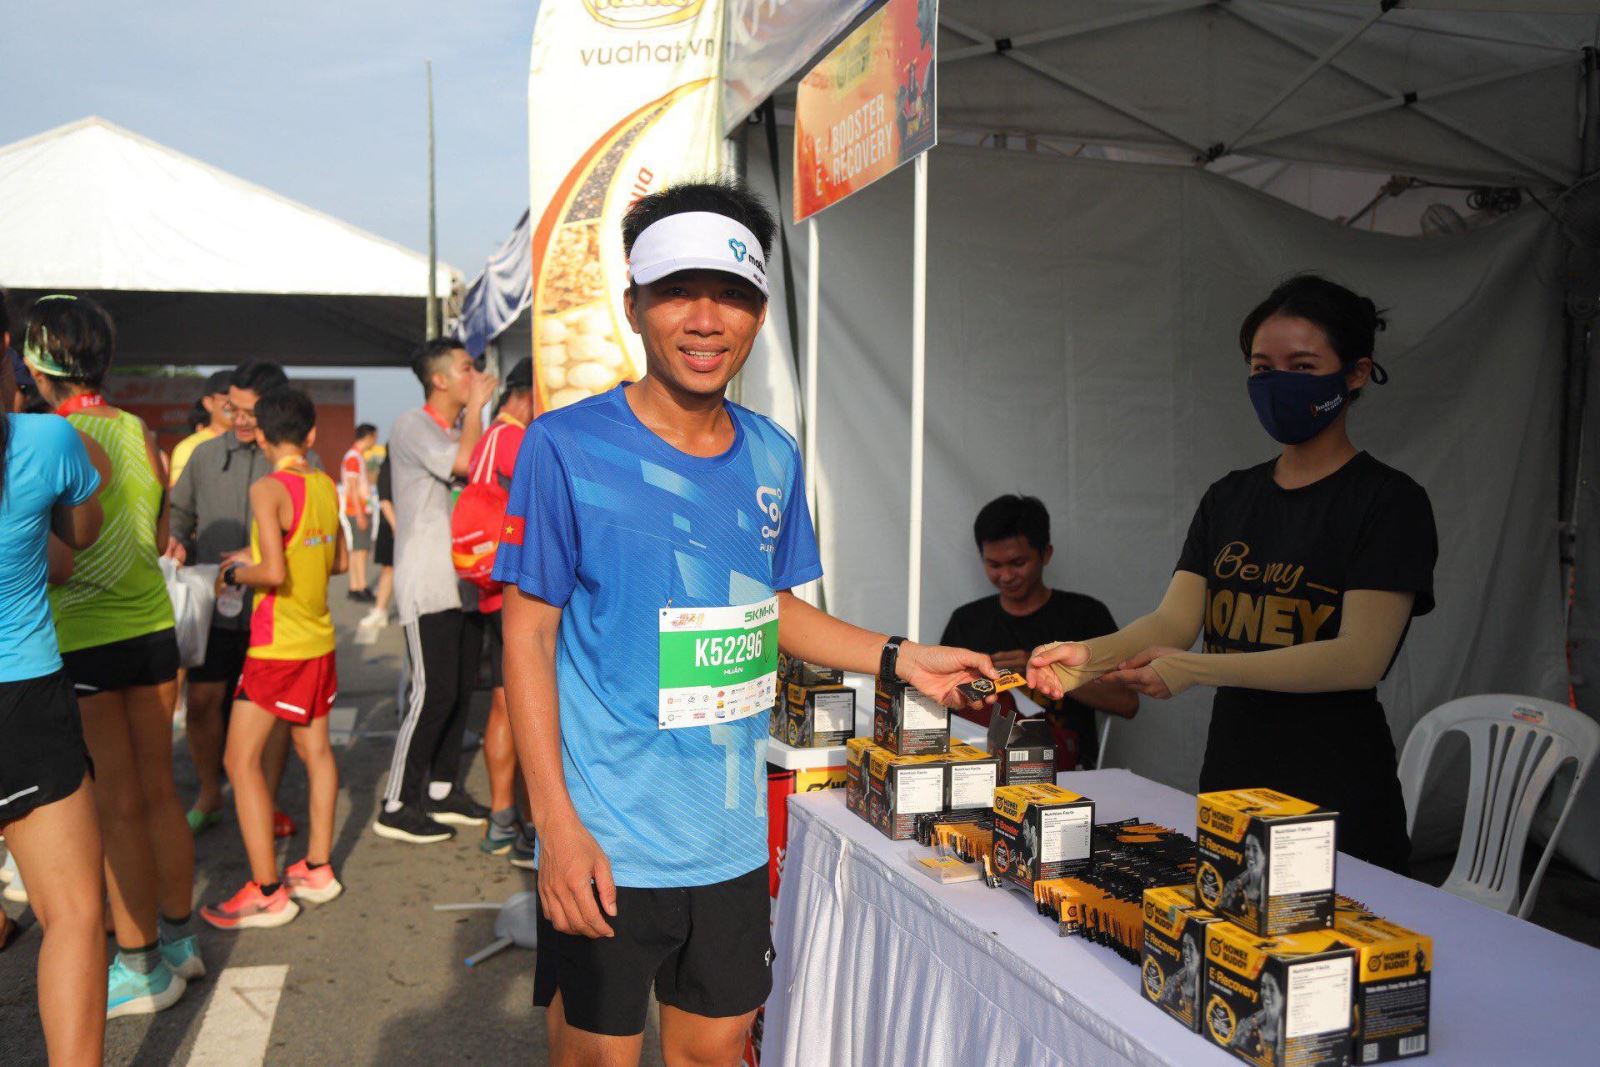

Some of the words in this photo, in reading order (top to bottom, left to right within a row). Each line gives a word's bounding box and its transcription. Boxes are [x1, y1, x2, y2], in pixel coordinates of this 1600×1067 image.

[1204, 589, 1336, 647] ONEY
[695, 630, 762, 667] K52296
[1212, 809, 1234, 823] HONEY
[1211, 820, 1233, 834] BUDDY
[1223, 943, 1248, 958] HONEY
[1384, 950, 1410, 960] HONEY
[1222, 953, 1248, 970] BUDDY
[1383, 960, 1410, 971] BUDDY
[1208, 967, 1258, 1004] E-Recovery
